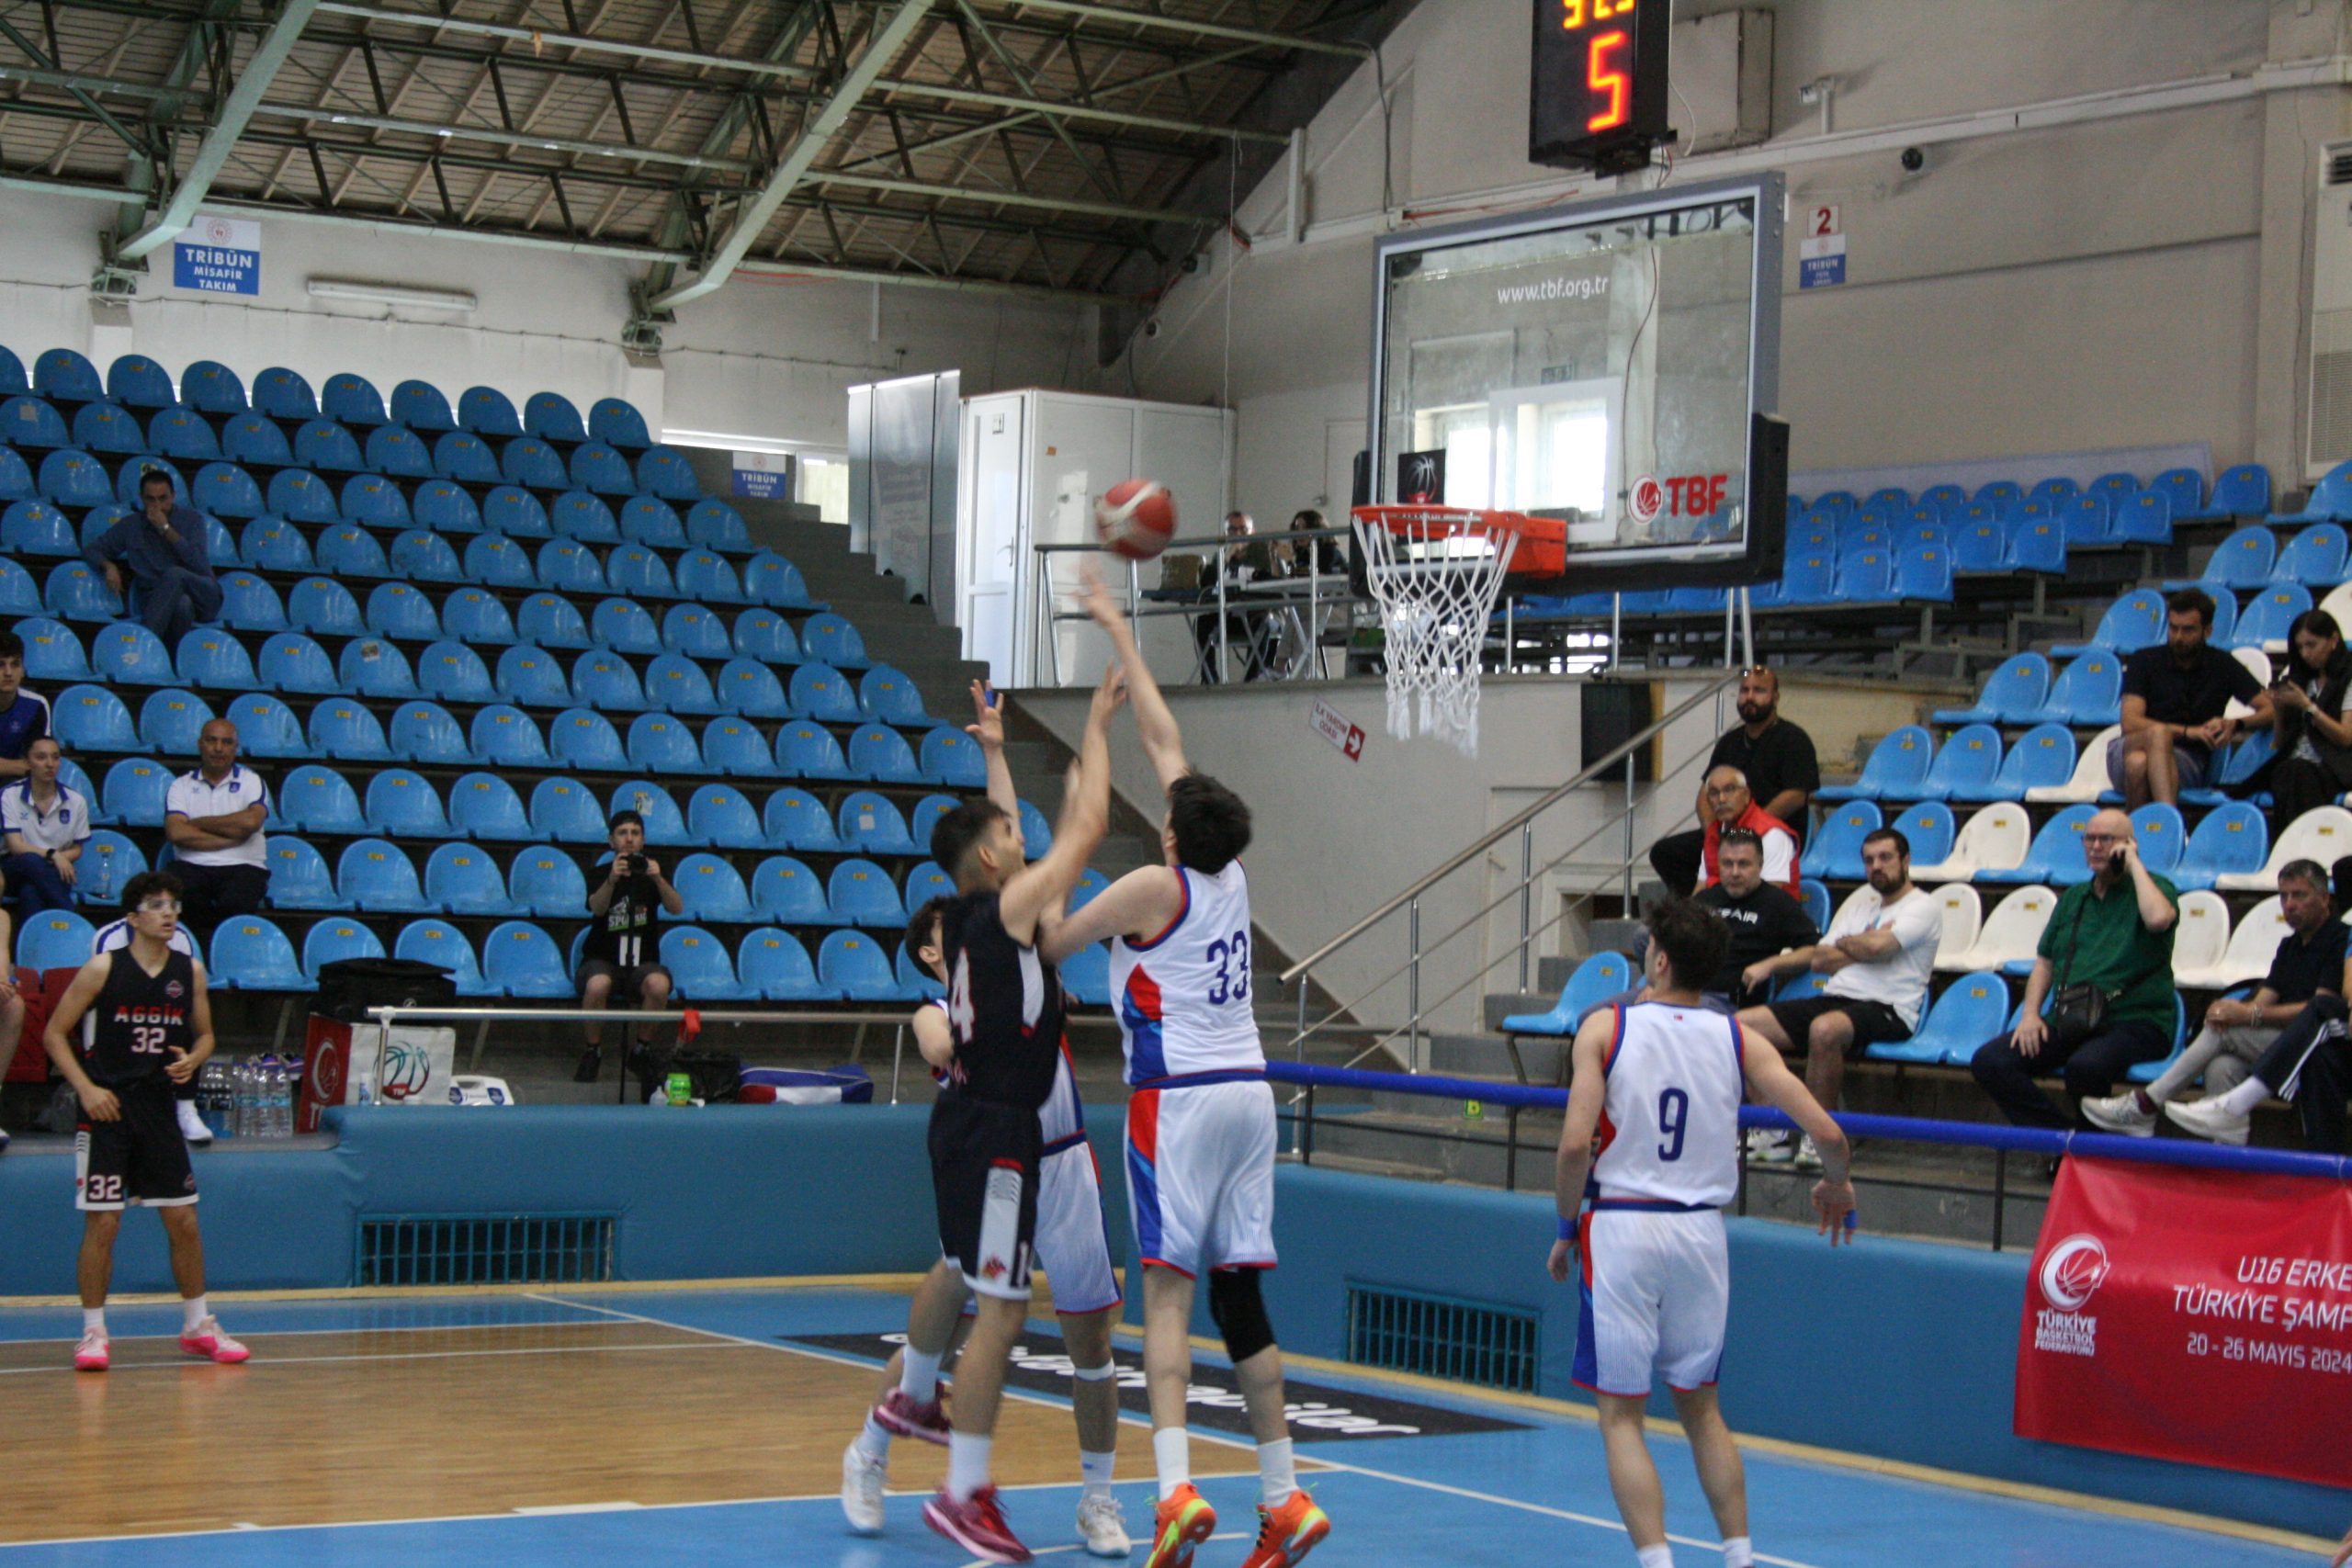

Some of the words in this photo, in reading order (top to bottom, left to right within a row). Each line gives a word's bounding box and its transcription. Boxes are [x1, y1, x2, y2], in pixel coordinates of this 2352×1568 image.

[1588, 29, 1628, 131] 5
[1816, 206, 1831, 235] 2
[186, 247, 253, 268] TRİBÜN
[194, 265, 243, 280] MİSAFİR
[198, 278, 237, 292] TAKIM
[1498, 276, 1609, 304] www.tbf.org.tr
[741, 472, 777, 485] TRİBÜN
[1665, 474, 1728, 517] TBF
[1206, 930, 1249, 1006] 33
[131, 1027, 166, 1054] 32
[1657, 1087, 1689, 1162] 9
[88, 1175, 122, 1201] 32
[2237, 1256, 2285, 1285] U16
[2286, 1258, 2352, 1292] ERKE
[2174, 1282, 2278, 1324] TÜRKİYE
[2036, 1307, 2098, 1335] TÜRKİYE
[2036, 1326, 2094, 1348] BASKETBOL
[2187, 1332, 2209, 1356] 20
[2222, 1337, 2245, 1360] 26
[2249, 1340, 2306, 1368] MAYIS
[2311, 1347, 2352, 1374] 2024
